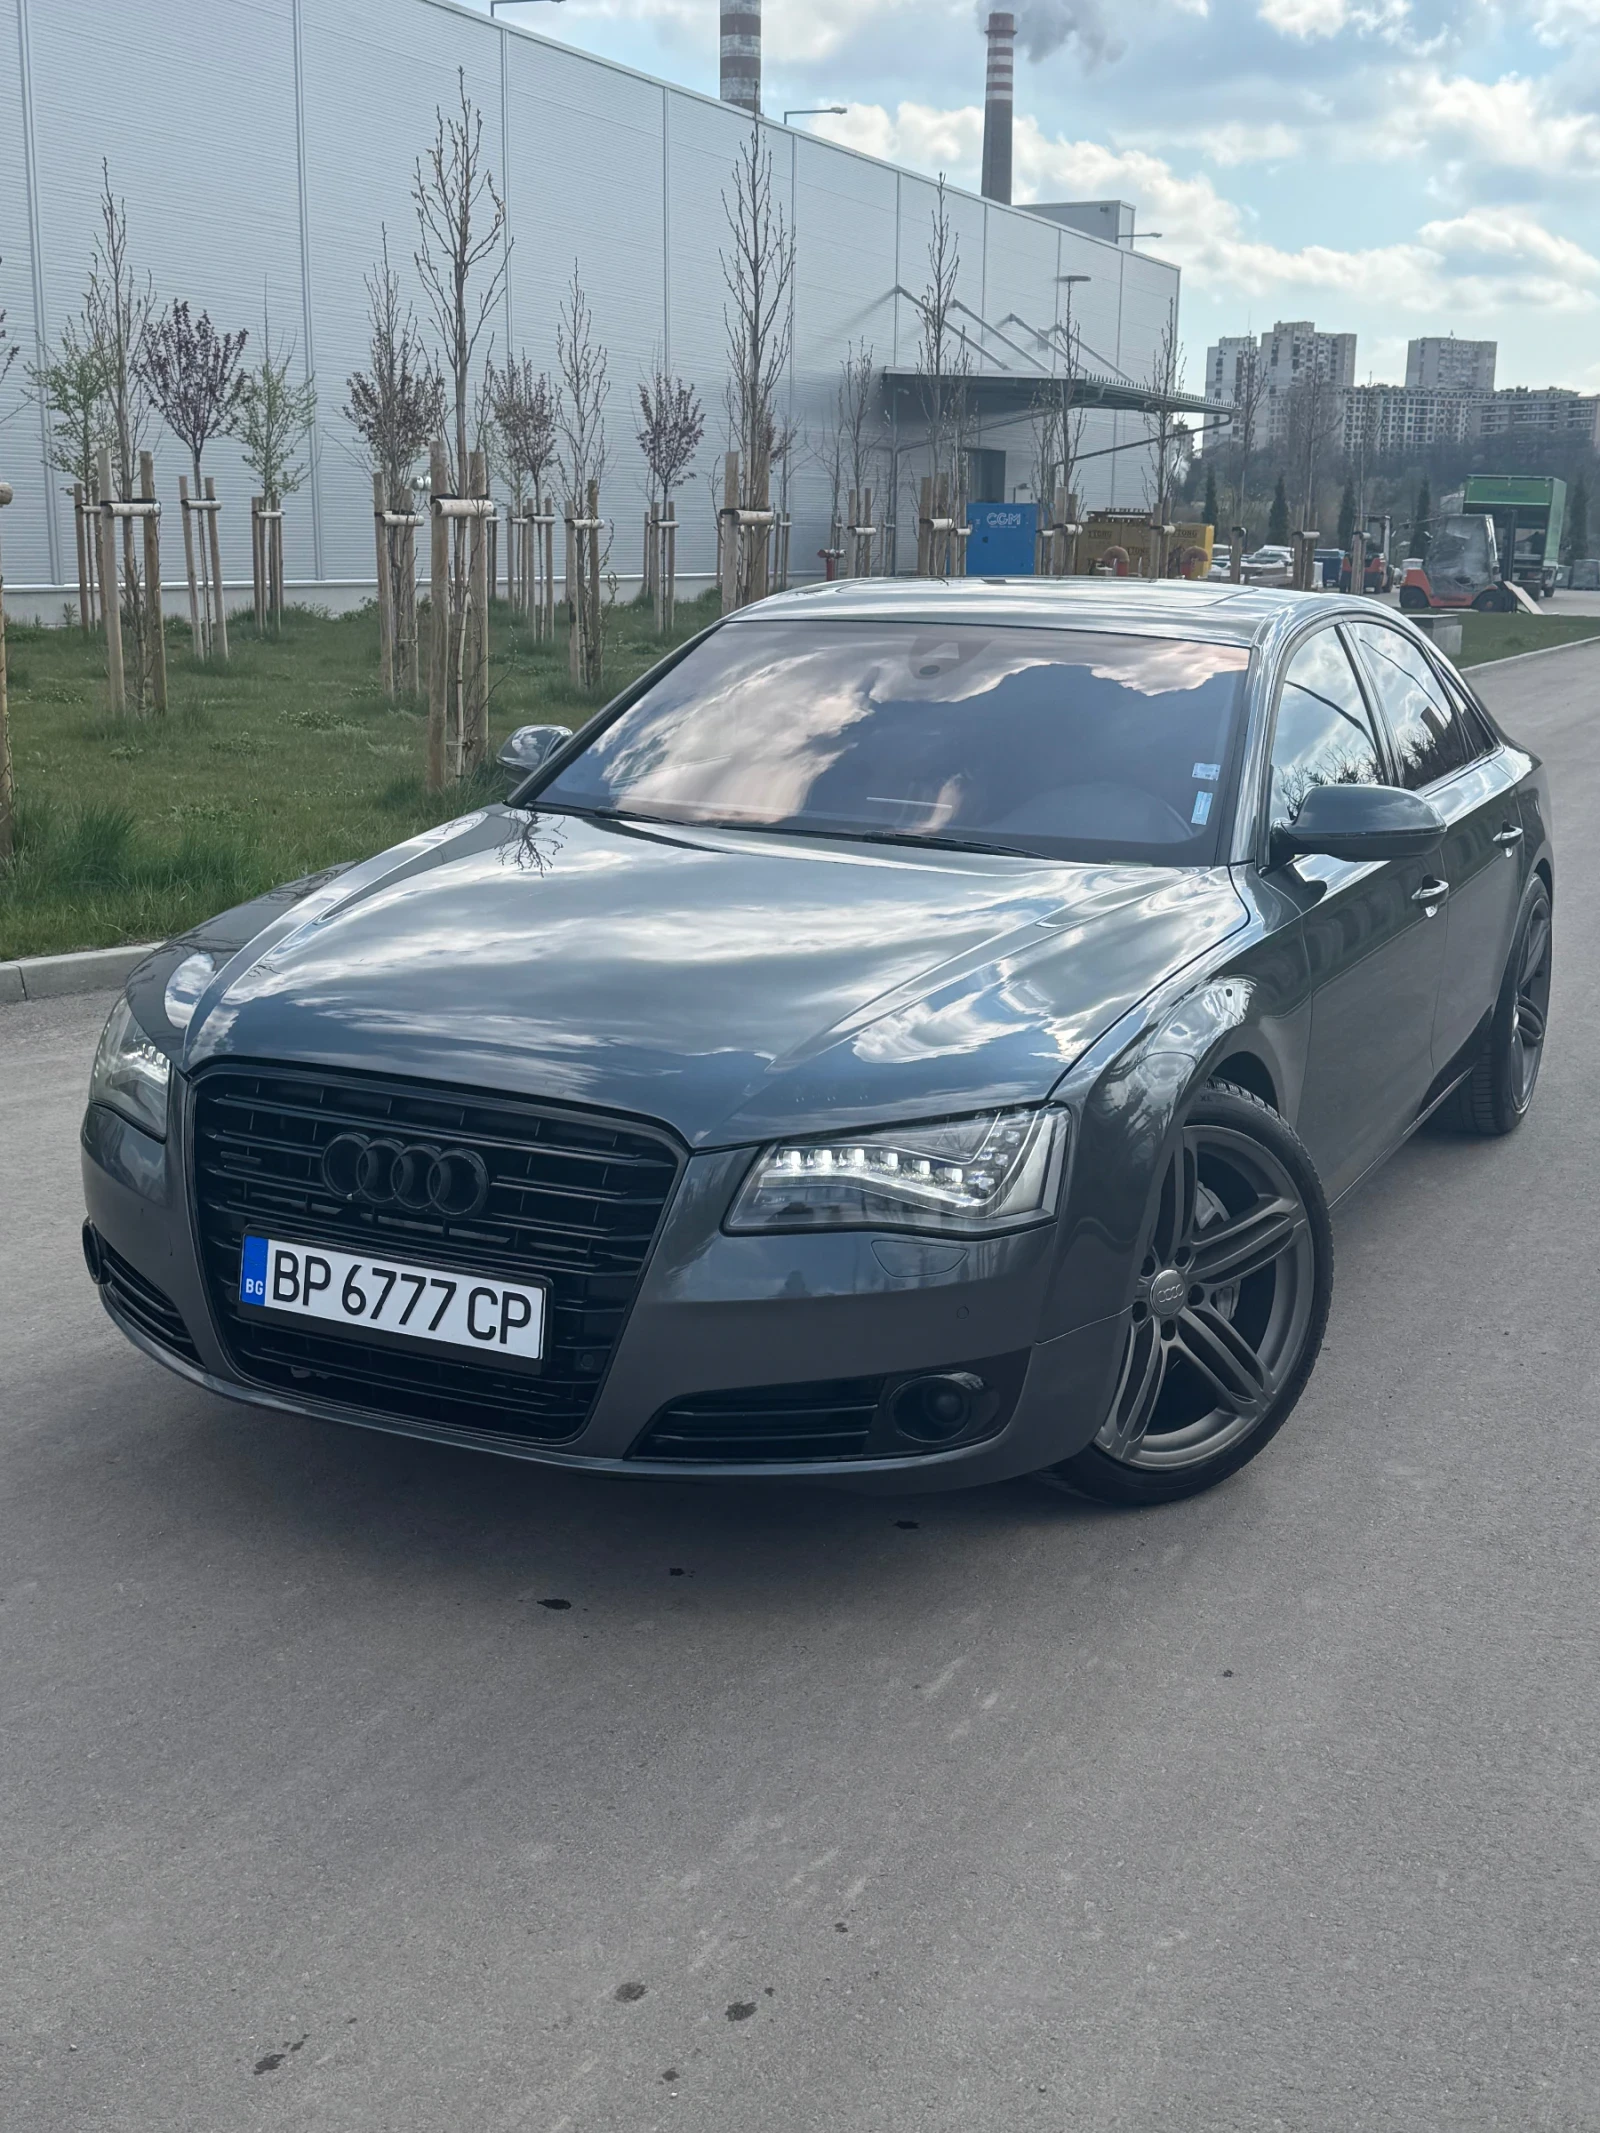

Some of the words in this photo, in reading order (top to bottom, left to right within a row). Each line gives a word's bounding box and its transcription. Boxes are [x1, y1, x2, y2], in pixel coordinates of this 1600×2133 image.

[245, 1278, 264, 1296] BG
[272, 1249, 332, 1306] BP
[341, 1264, 457, 1331] 6777
[467, 1286, 532, 1344] CP
